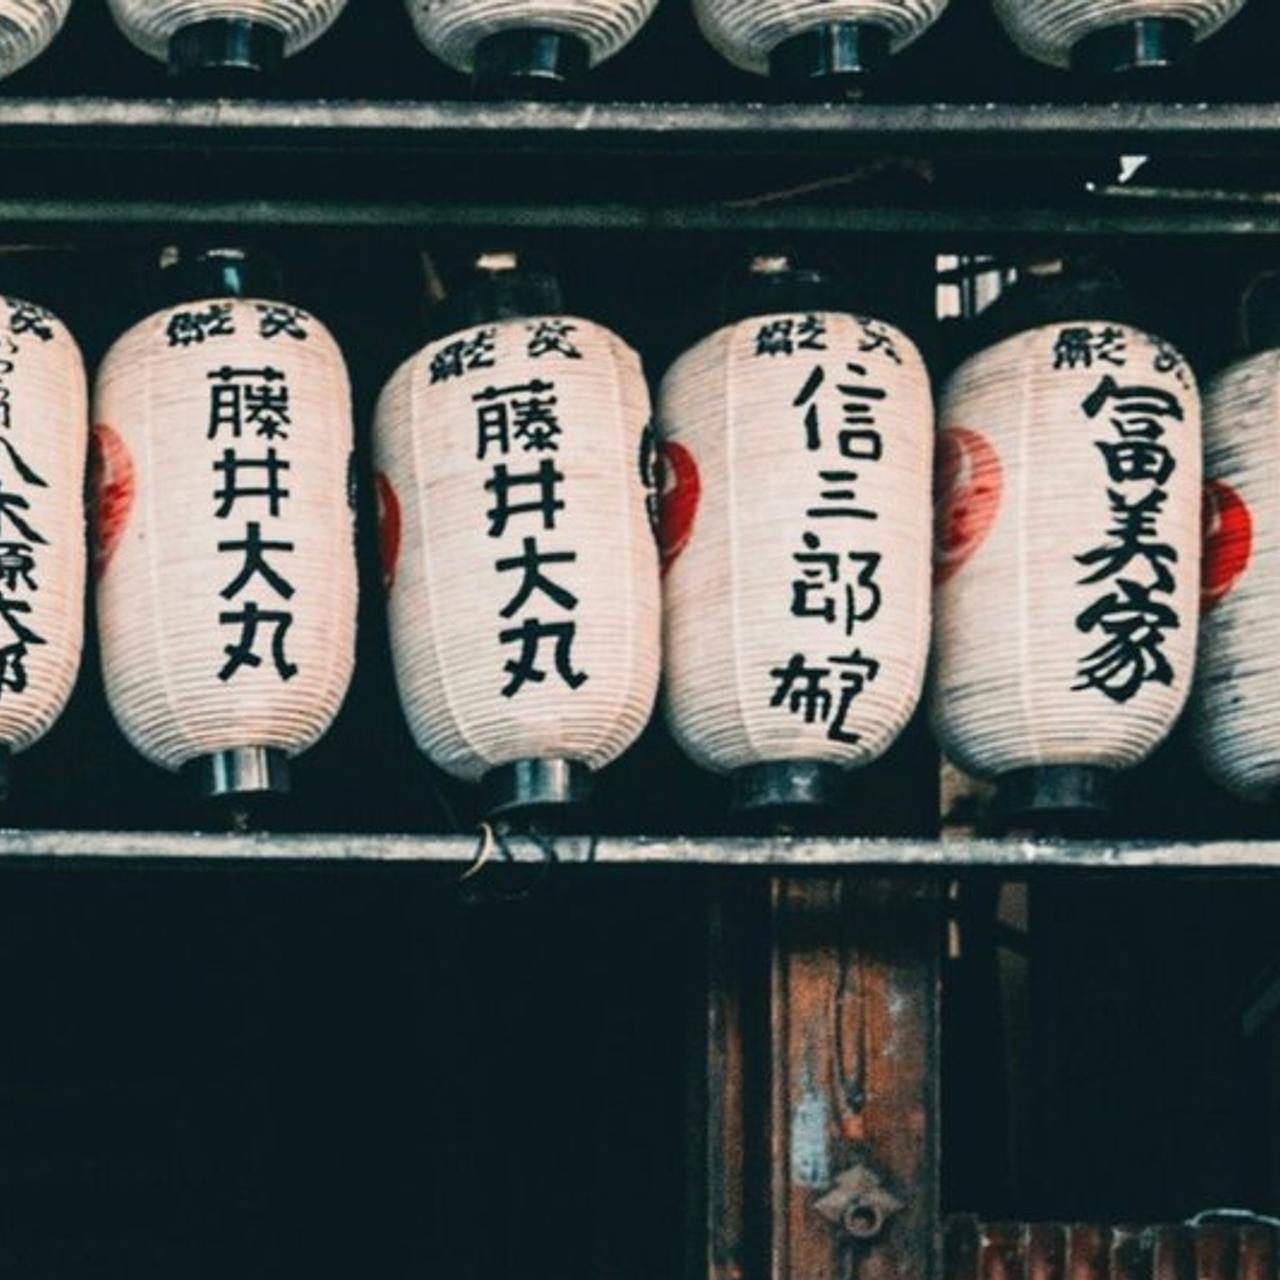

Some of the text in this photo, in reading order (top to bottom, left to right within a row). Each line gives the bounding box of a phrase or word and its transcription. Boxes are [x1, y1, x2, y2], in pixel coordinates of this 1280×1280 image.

[205, 364, 299, 683] 藤井大丸
[470, 378, 589, 699] 藤井大丸
